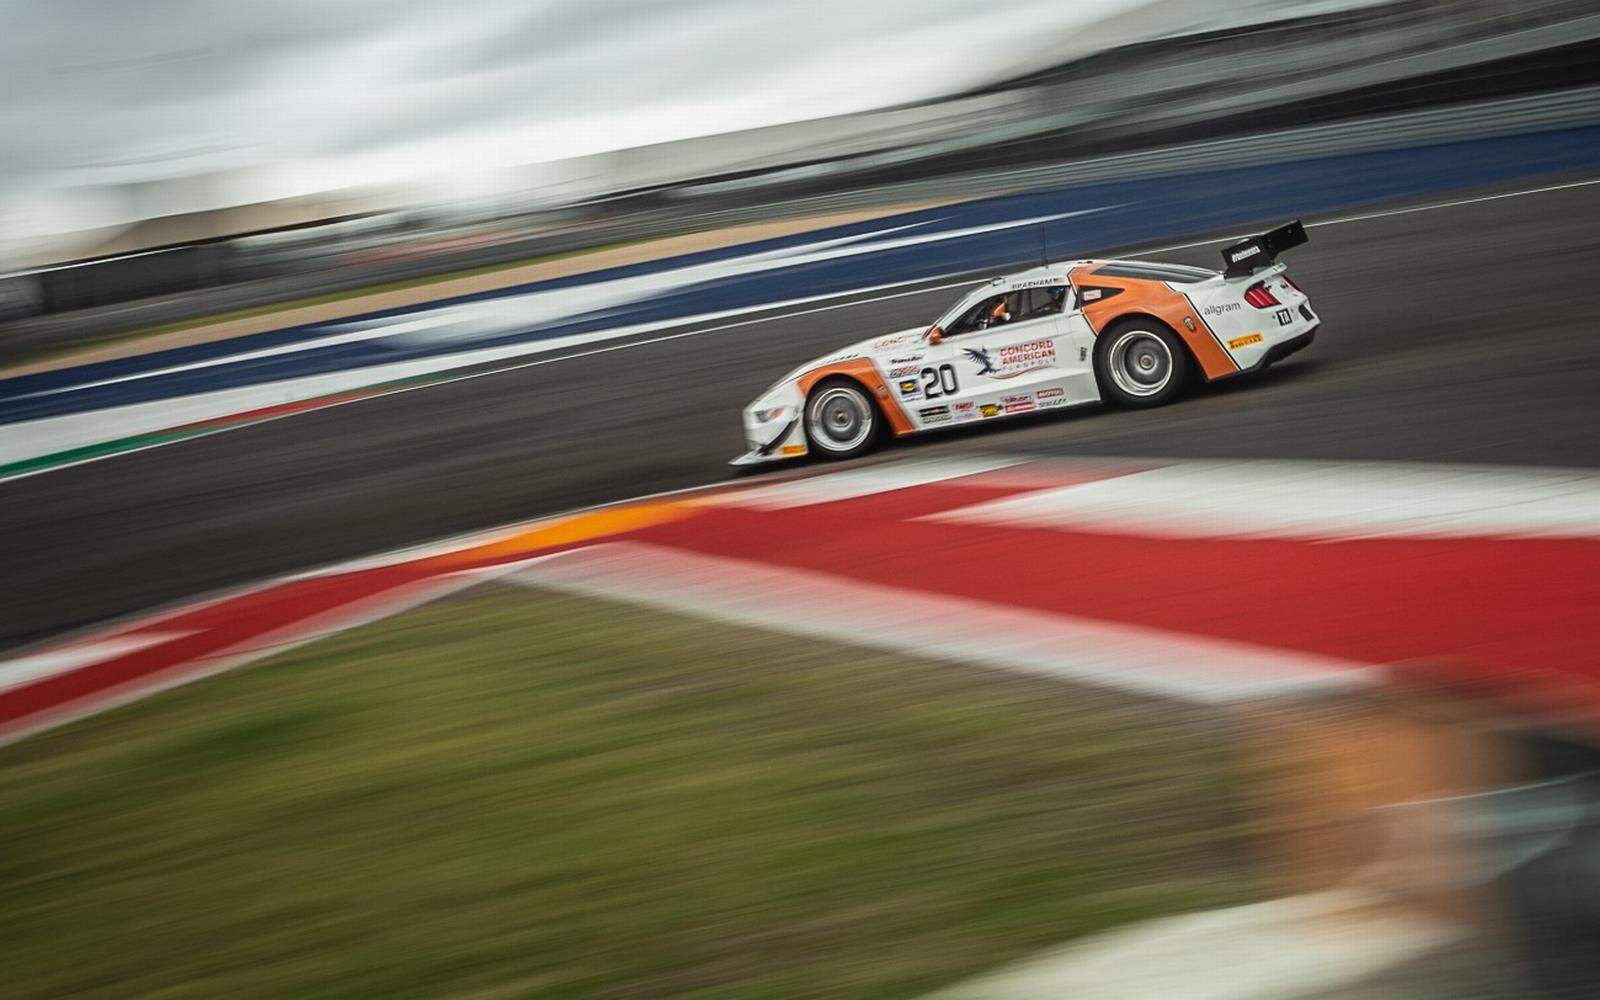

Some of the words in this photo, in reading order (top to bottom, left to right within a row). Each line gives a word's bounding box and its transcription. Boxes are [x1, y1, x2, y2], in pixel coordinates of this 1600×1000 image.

[1204, 301, 1242, 316] allgram
[1000, 340, 1054, 357] CONCORD
[1002, 348, 1056, 365] AMERICAN
[921, 363, 959, 400] 20
